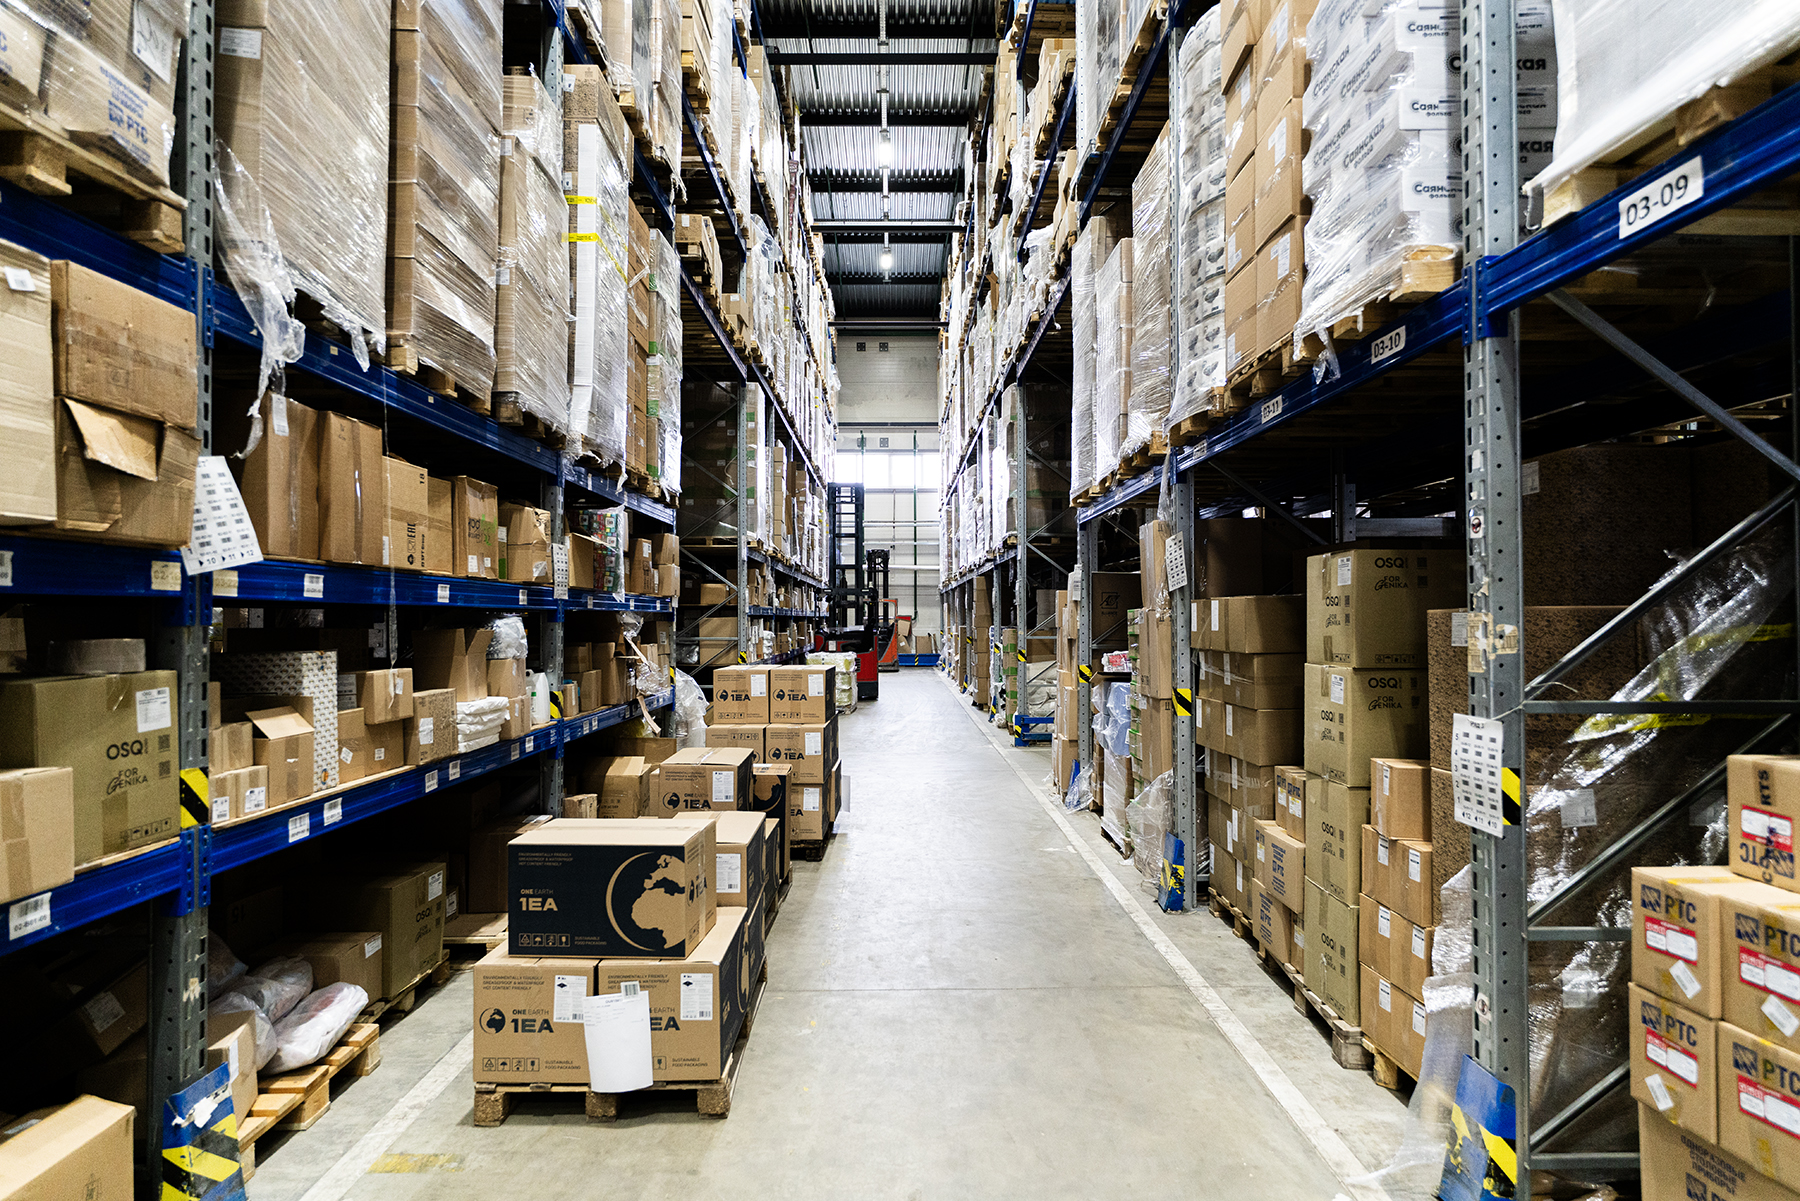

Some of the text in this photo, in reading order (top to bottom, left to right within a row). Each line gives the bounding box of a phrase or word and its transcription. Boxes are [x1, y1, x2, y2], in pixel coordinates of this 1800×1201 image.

[1411, 102, 1441, 111] Саян
[1626, 174, 1689, 226] 03-09
[1373, 331, 1401, 359] 03-10
[1262, 400, 1279, 419] 03-11
[206, 557, 217, 565] 10
[1374, 557, 1404, 569] OSQ
[1374, 579, 1409, 591] GENIKA
[1325, 595, 1339, 607] OSQ
[1367, 677, 1398, 689] OSQ
[787, 693, 807, 701] 1EA
[1368, 700, 1403, 711] GENIKA
[1321, 709, 1334, 722] OSQ
[106, 739, 143, 760] OSQ
[783, 752, 805, 760] 1EA
[118, 767, 138, 778] FOR
[106, 775, 148, 795] GENIKA
[683, 799, 711, 809] 1EA
[1465, 812, 1471, 820] 12
[1491, 821, 1497, 829] 10
[1321, 821, 1335, 837] OSQ
[519, 897, 558, 912] 1EA
[1321, 932, 1334, 950] OSQ
[510, 1018, 554, 1033] 1EA
[650, 1016, 680, 1031] EA
